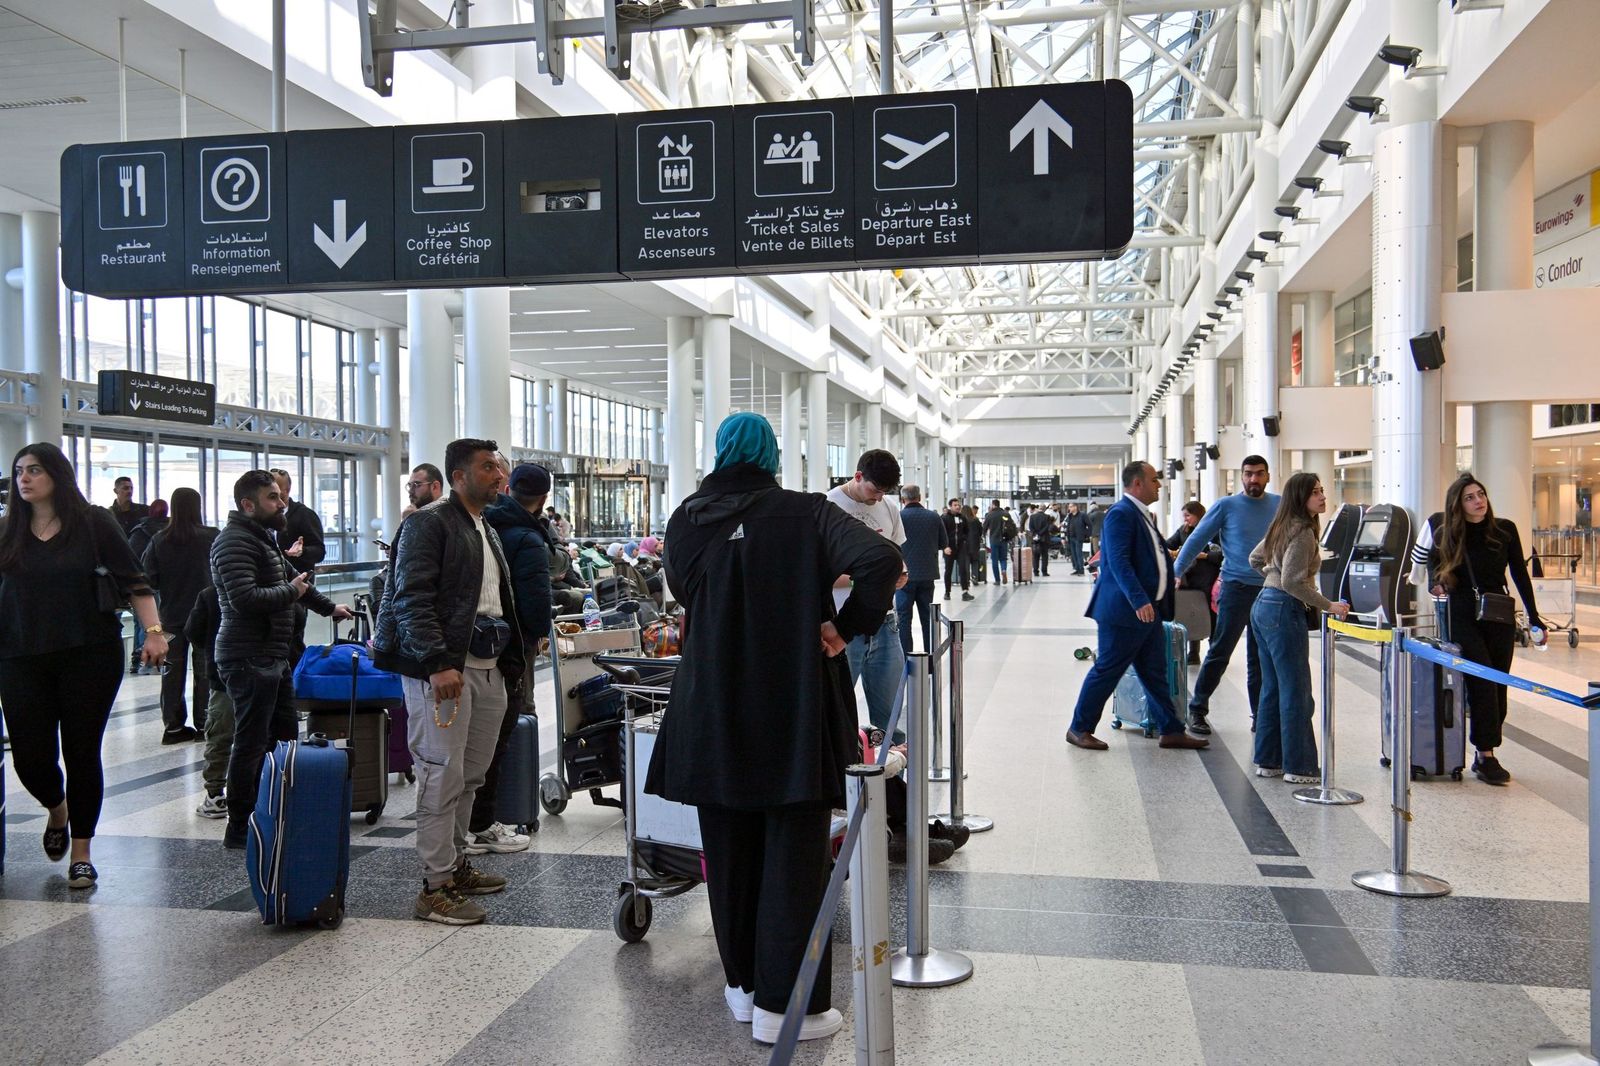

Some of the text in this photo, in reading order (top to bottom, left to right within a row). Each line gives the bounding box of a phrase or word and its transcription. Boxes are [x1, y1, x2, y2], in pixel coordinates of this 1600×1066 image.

[652, 208, 701, 220] مصاعد
[918, 198, 958, 214] ذهاب
[745, 205, 845, 224] بيع تذاكر السفر
[861, 213, 972, 232] Departure East
[1535, 208, 1574, 235] Eurowings
[427, 221, 472, 238] كافتيريا
[644, 225, 709, 240] Elevators
[751, 220, 840, 236] Ticket Sales
[116, 239, 152, 253] مطعم
[206, 231, 268, 245] استعلامات
[406, 236, 492, 251] Coffee Shop
[742, 235, 855, 253] Vente de Billets
[876, 230, 957, 249] Départ Est
[101, 251, 167, 265] Restaurant
[202, 245, 271, 260] Information
[418, 251, 480, 266] Cafétéria
[638, 246, 716, 260] Ascenseurs
[191, 260, 282, 277] Renseignement
[1548, 256, 1583, 282] Condor
[144, 400, 207, 417] Stairs Leading To Parking
